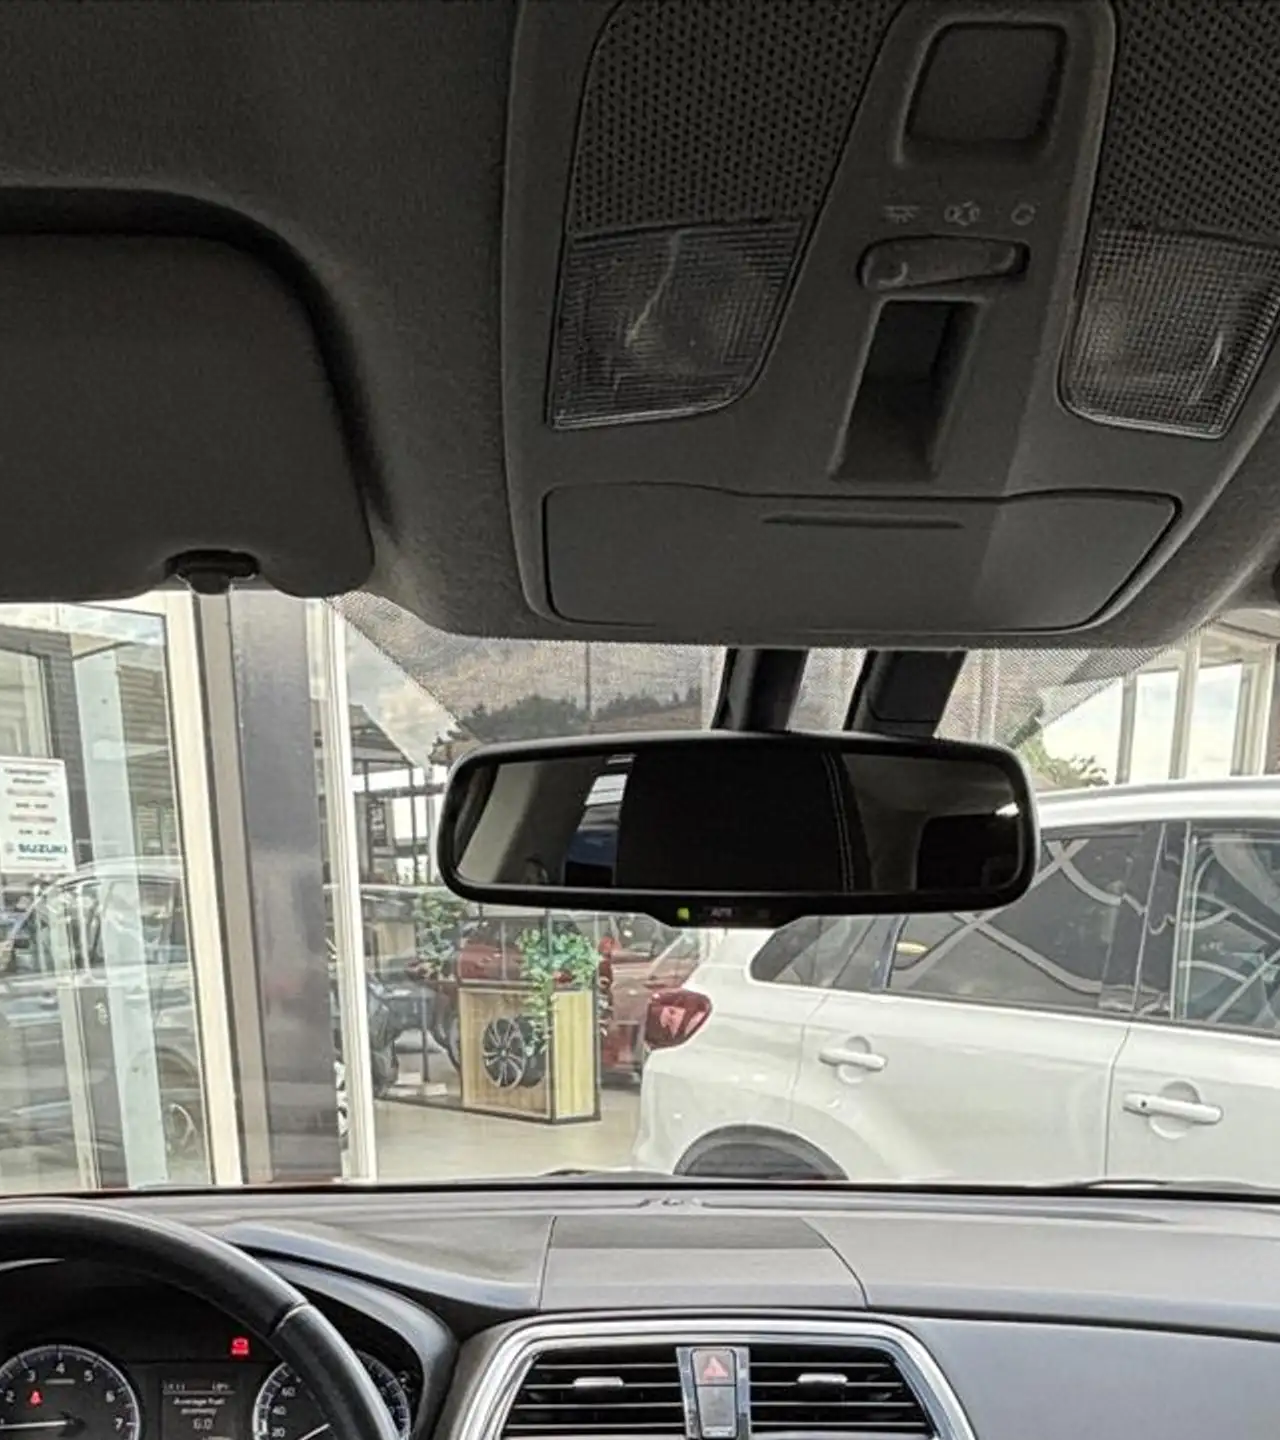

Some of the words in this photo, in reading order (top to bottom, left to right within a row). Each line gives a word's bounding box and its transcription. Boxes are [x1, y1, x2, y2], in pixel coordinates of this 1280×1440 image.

[18, 843, 67, 854] SUZUKI
[55, 1361, 65, 1375] 4
[27, 1369, 37, 1383] 3
[83, 1369, 94, 1382] 5
[5, 1389, 15, 1403] 2
[114, 1417, 124, 1431] 7
